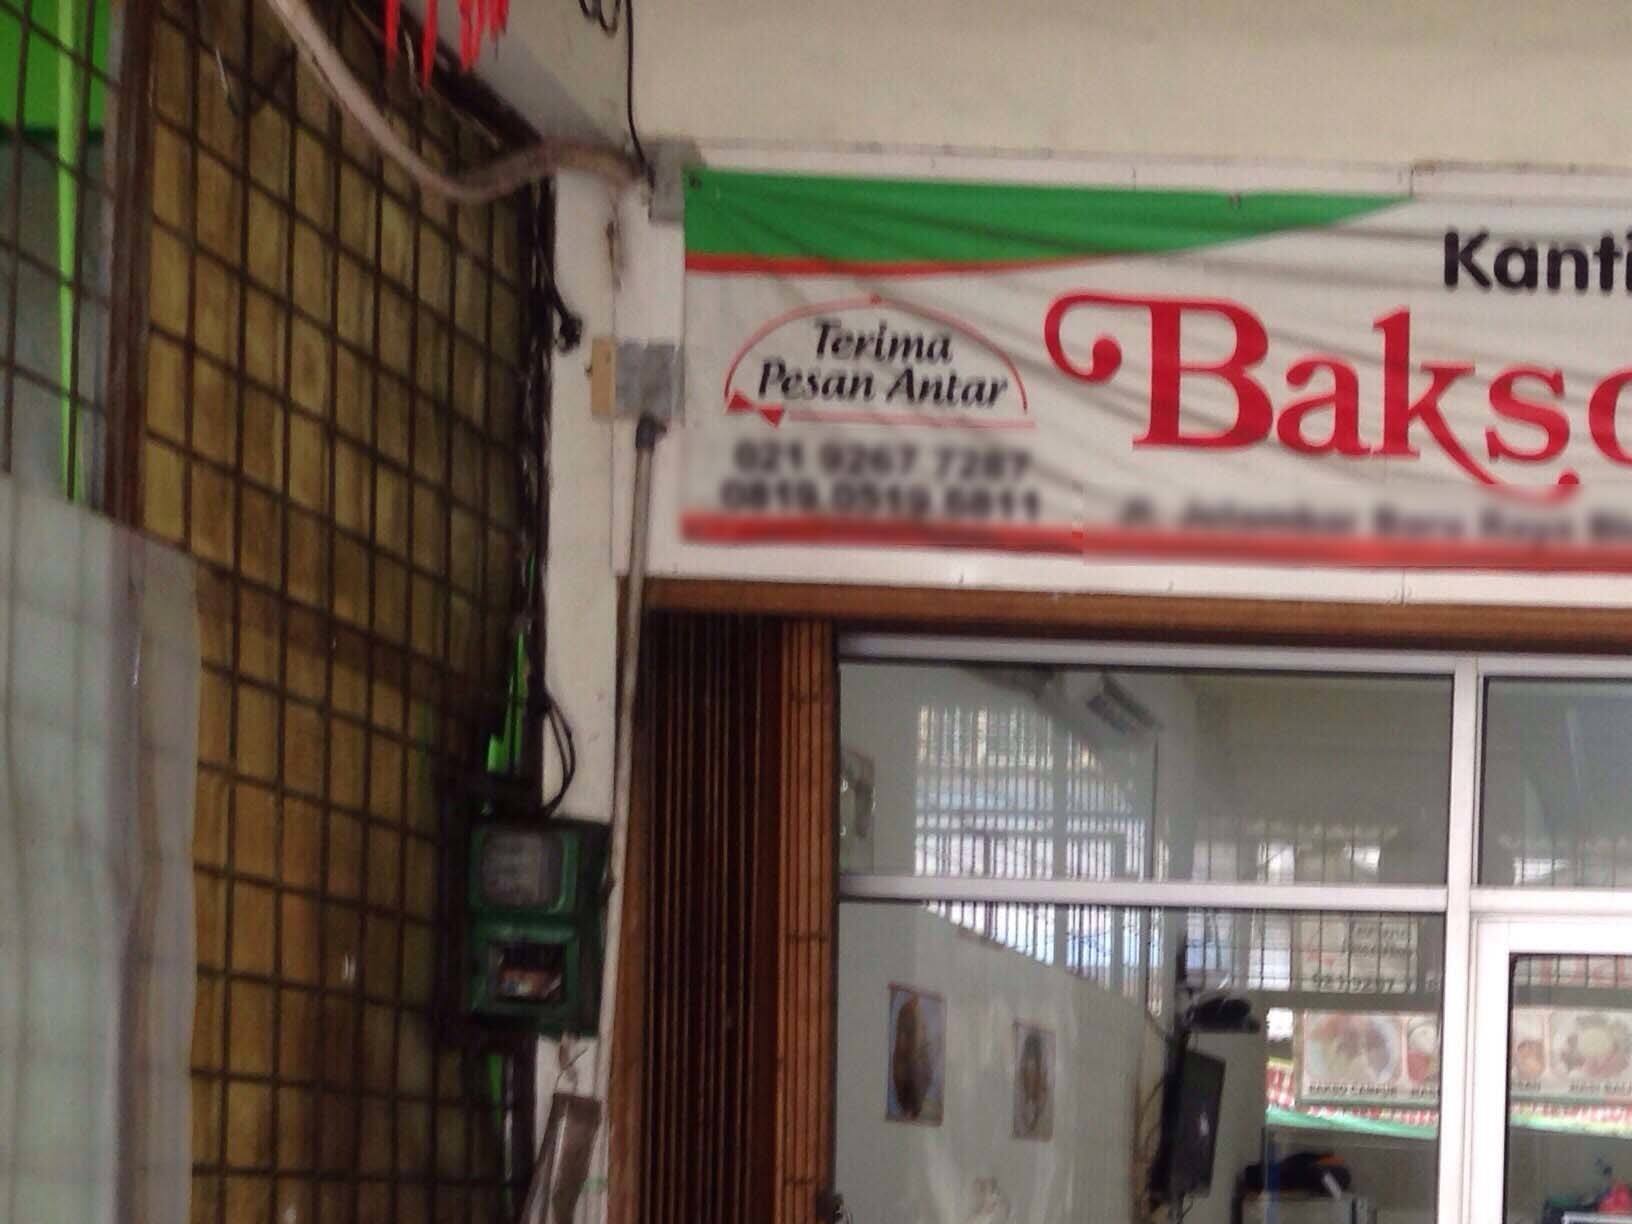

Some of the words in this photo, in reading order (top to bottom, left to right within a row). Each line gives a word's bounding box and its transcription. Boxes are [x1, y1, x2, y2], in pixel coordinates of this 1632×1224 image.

[814, 318, 953, 362] Terima
[757, 355, 876, 403] Pesan
[884, 368, 1009, 409] Antar
